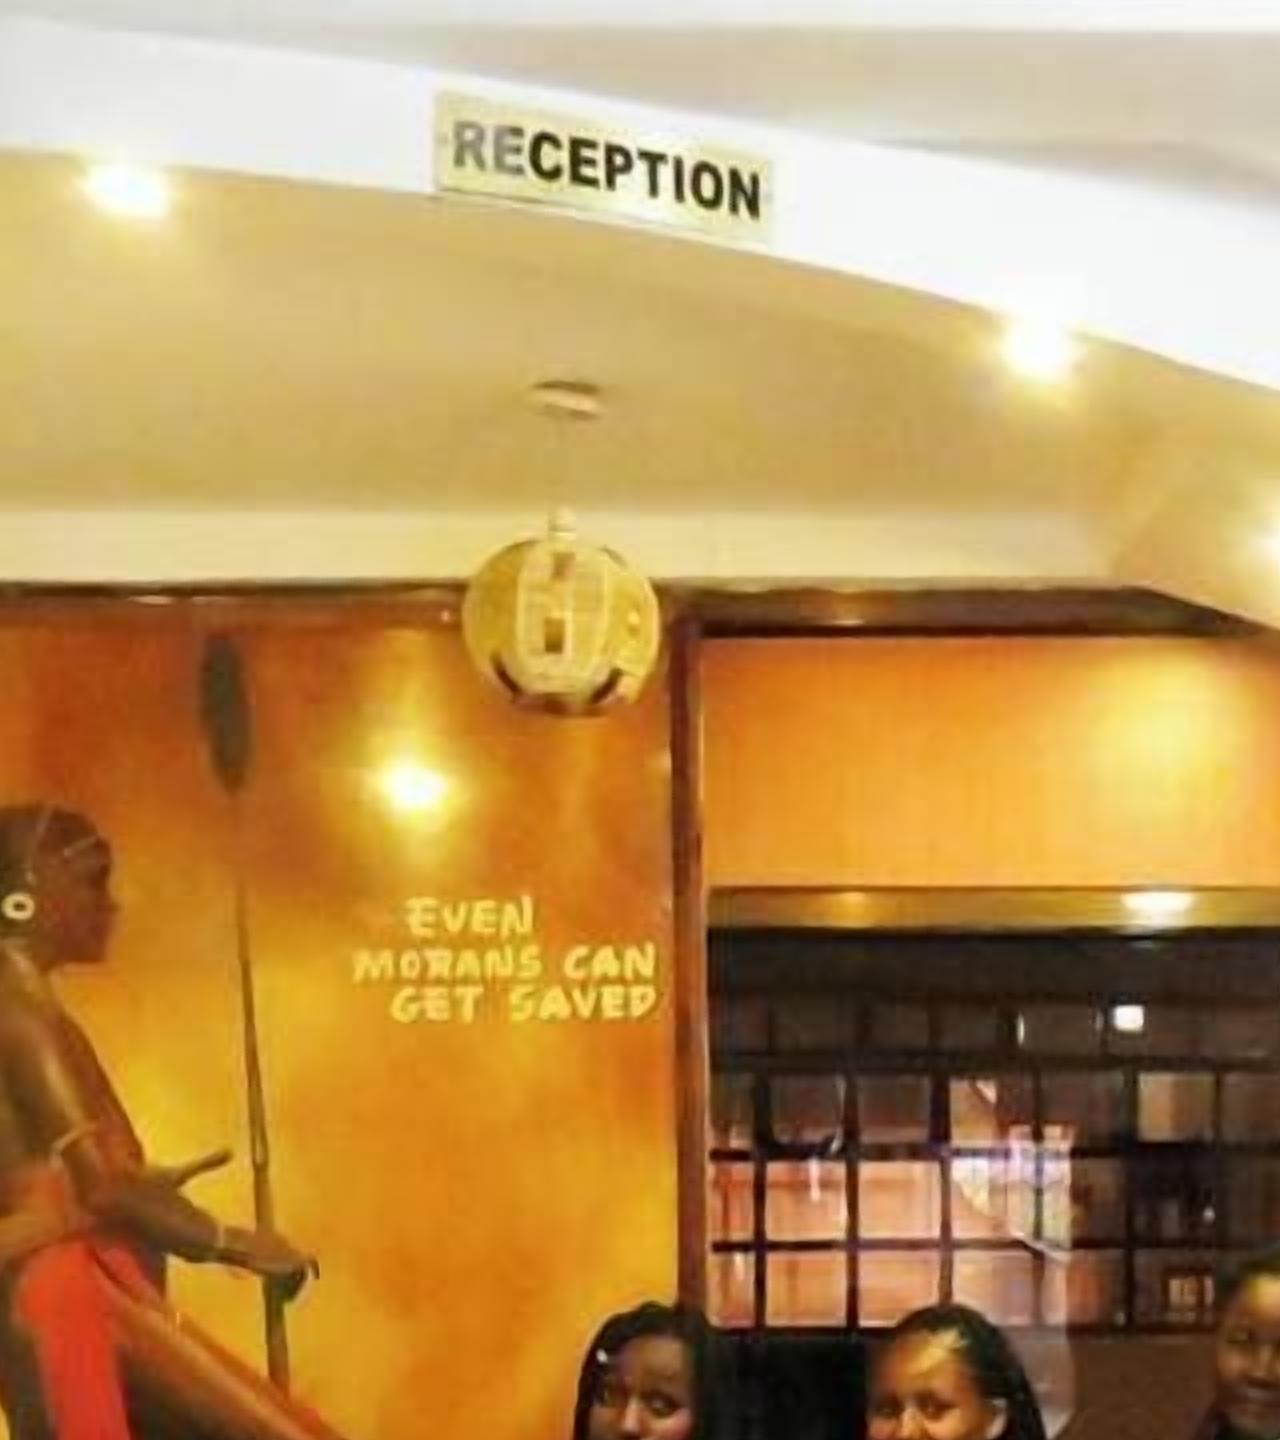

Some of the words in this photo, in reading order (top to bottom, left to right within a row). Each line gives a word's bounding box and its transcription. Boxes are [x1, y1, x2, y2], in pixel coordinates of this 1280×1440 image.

[453, 120, 761, 220] RECEPTION
[404, 894, 535, 938] EVEN
[351, 944, 543, 984] MORANS
[563, 940, 656, 981] CAN
[390, 985, 485, 1024] GET
[508, 985, 658, 1023] SAVED
